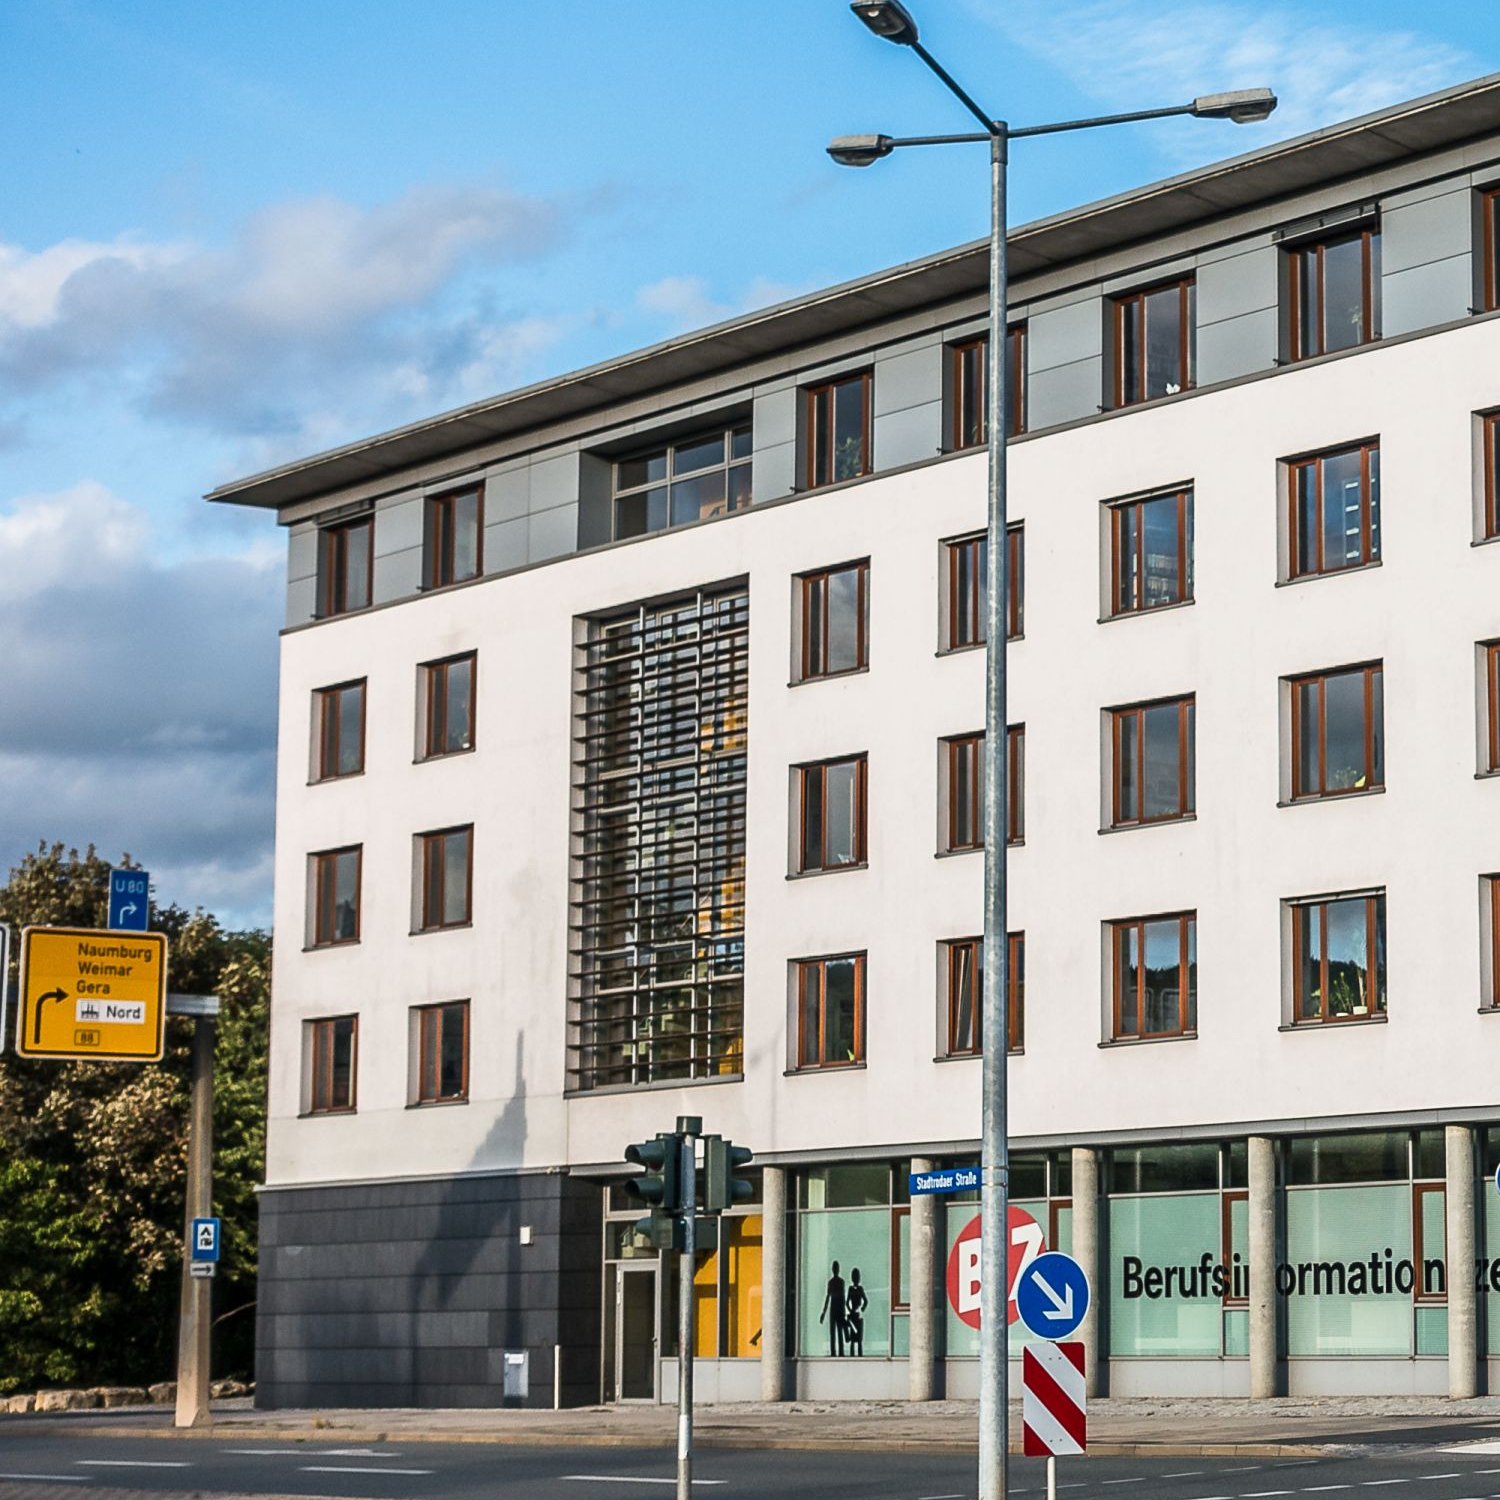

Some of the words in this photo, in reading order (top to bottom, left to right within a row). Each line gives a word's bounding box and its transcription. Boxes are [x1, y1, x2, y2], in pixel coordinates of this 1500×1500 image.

[115, 880, 126, 893] U
[127, 880, 145, 894] 80
[78, 943, 152, 963] Naumburg
[78, 961, 133, 976] Weimar
[76, 980, 111, 994] Gera
[106, 1005, 141, 1020] Nord
[80, 1032, 94, 1043] 88
[916, 1174, 954, 1190] Stadtrodaer
[955, 1171, 977, 1187] Straße
